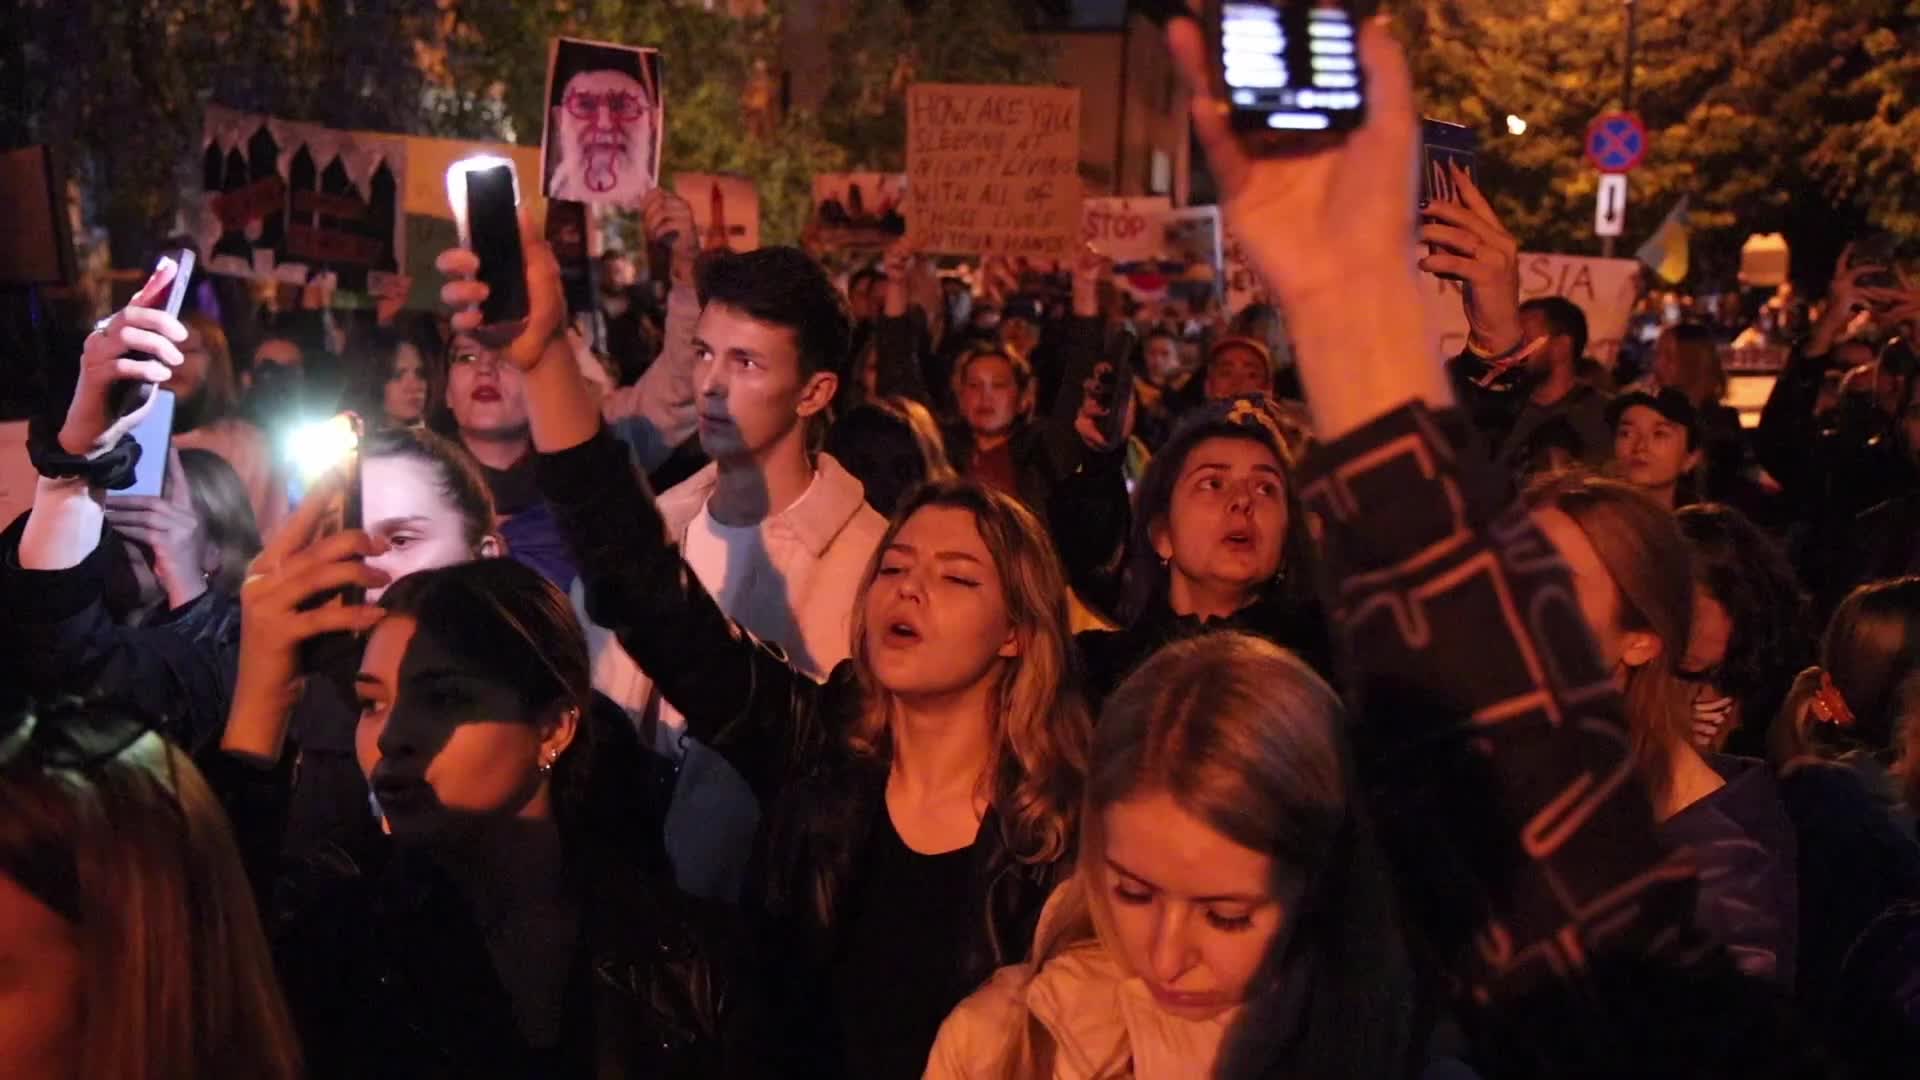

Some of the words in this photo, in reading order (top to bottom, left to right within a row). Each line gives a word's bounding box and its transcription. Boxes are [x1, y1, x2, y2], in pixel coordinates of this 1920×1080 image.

[913, 95, 970, 125] HOW
[976, 96, 1024, 126] ARE
[1029, 98, 1073, 132] YOU
[913, 129, 1007, 153] SLEEPING
[1015, 132, 1056, 153] AT
[913, 182, 968, 205] WITH
[977, 182, 1013, 207] ALL
[1023, 180, 1056, 207] OF
[1084, 210, 1146, 239] STOP
